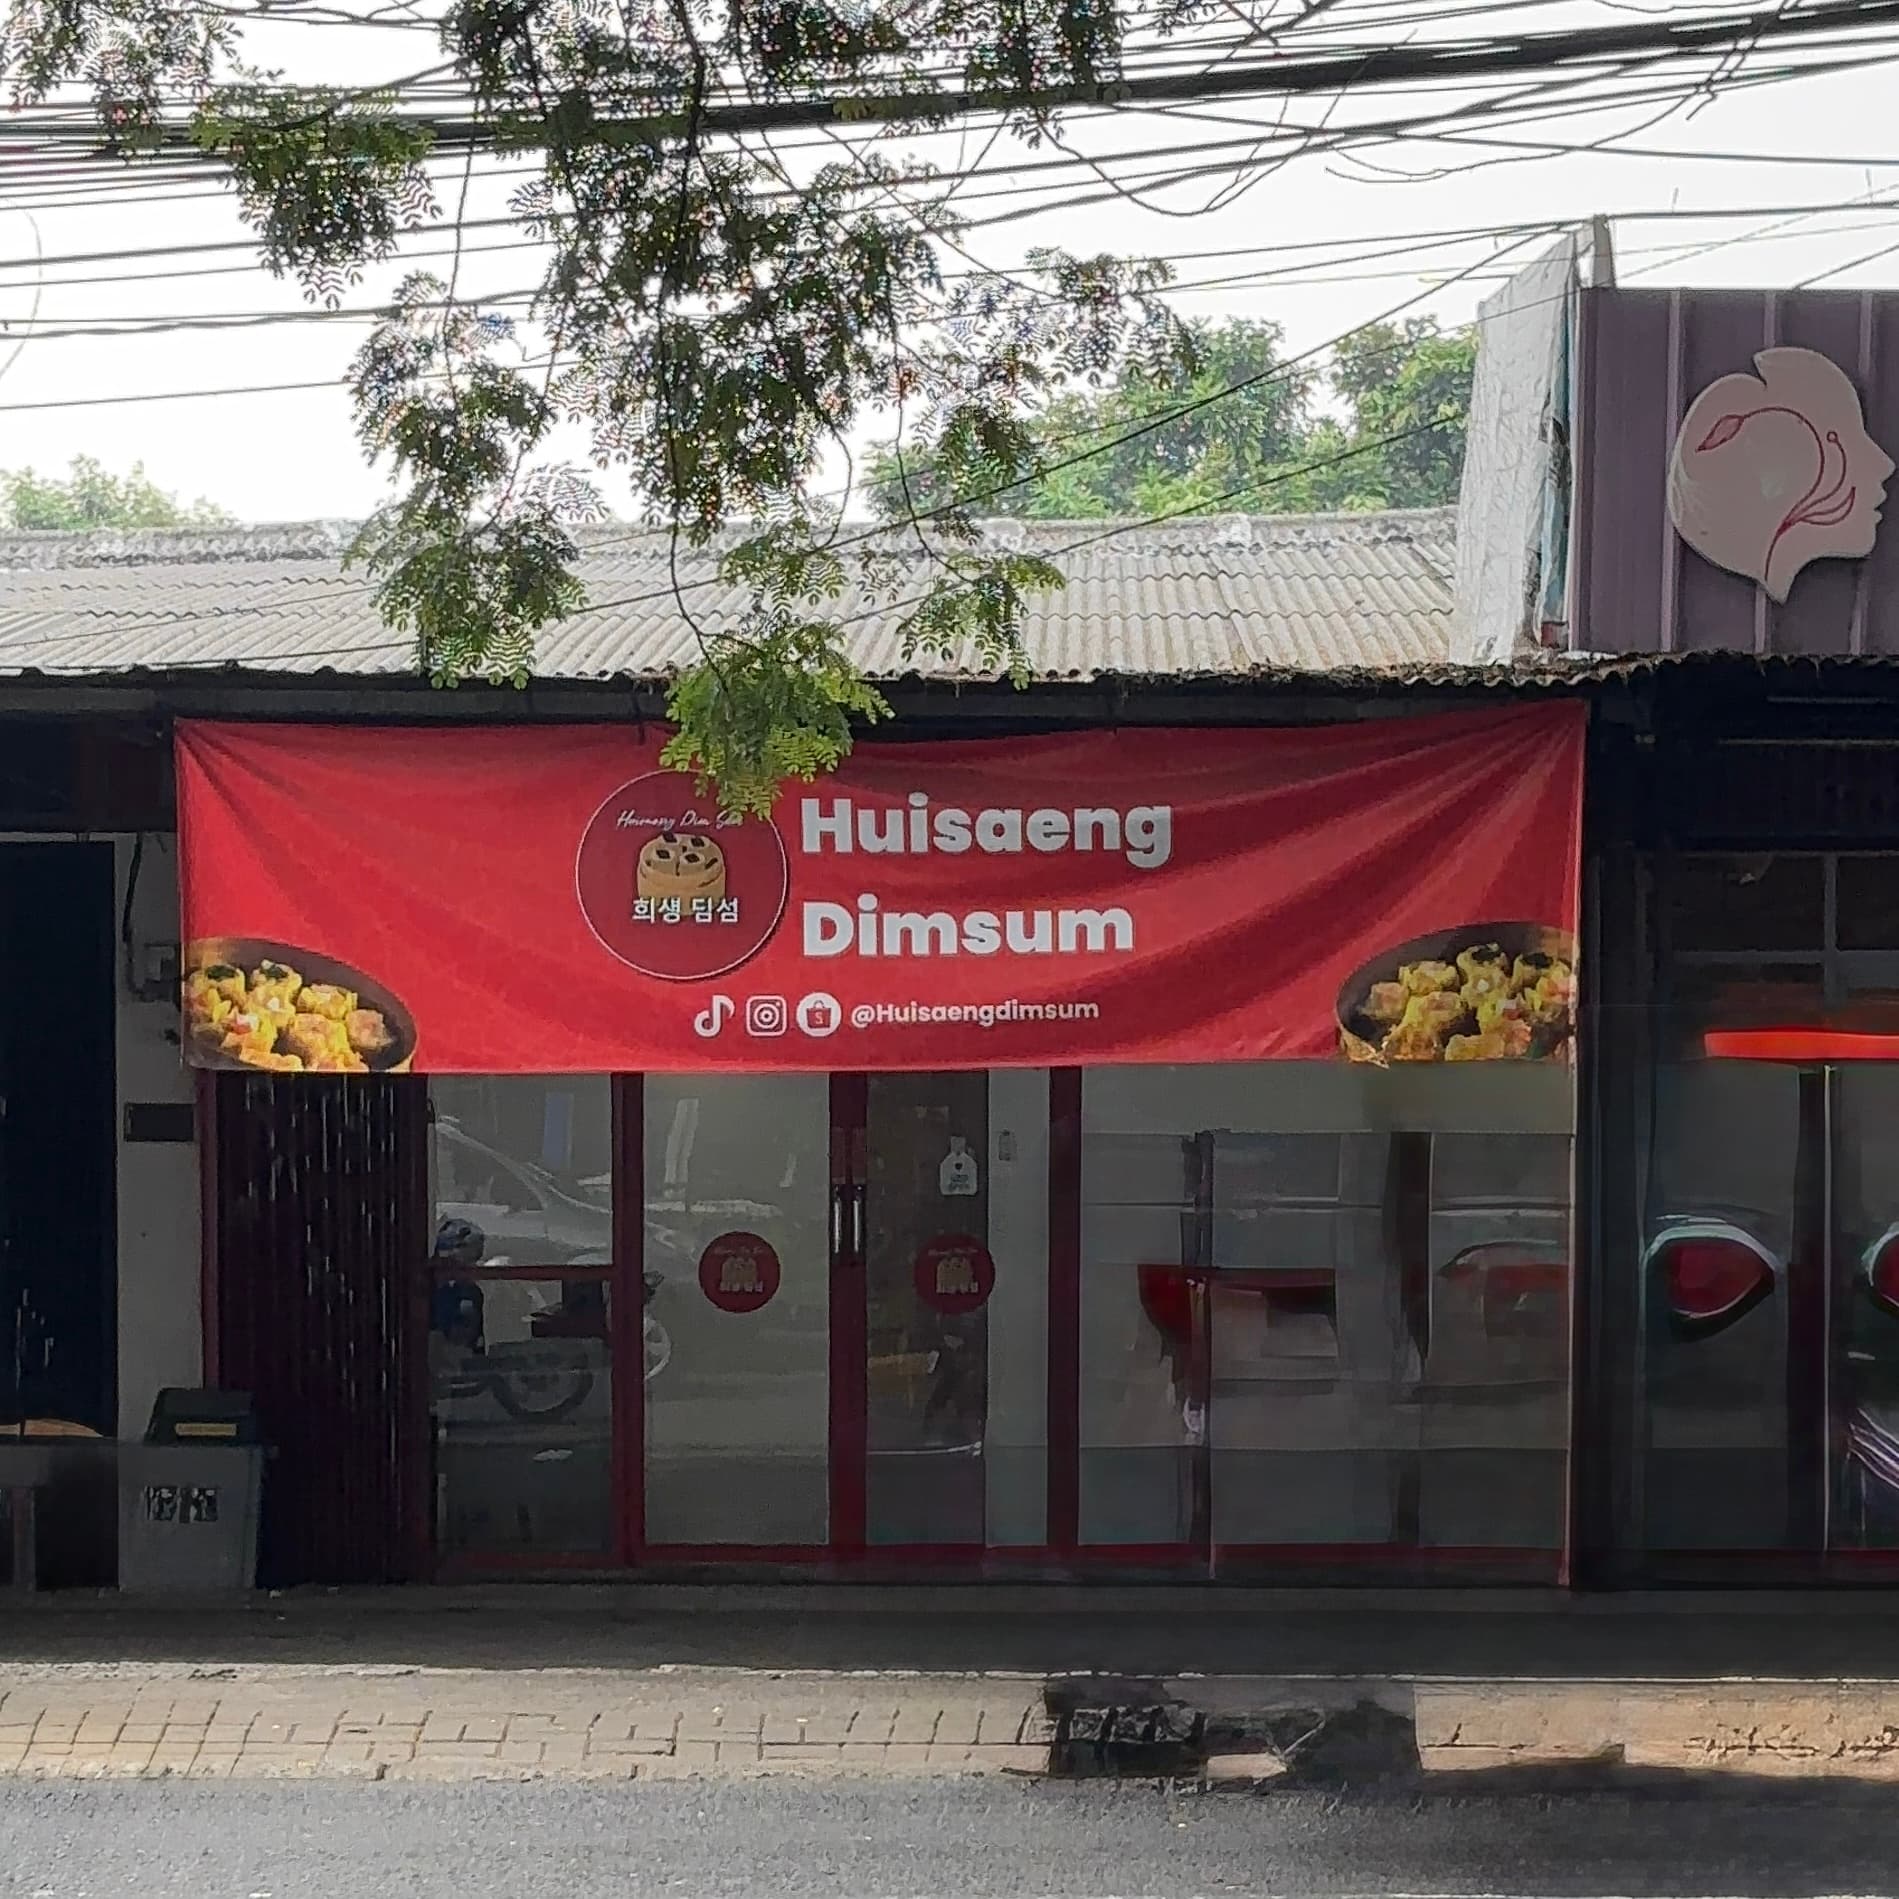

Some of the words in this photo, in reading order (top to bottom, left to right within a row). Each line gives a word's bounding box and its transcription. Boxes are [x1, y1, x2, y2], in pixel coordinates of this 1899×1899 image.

[801, 792, 1173, 868] Huisaeng
[692, 896, 739, 923] 딤섬
[803, 893, 1134, 956] Dimsum
[851, 999, 1100, 1028] @Huisaengdimsum
